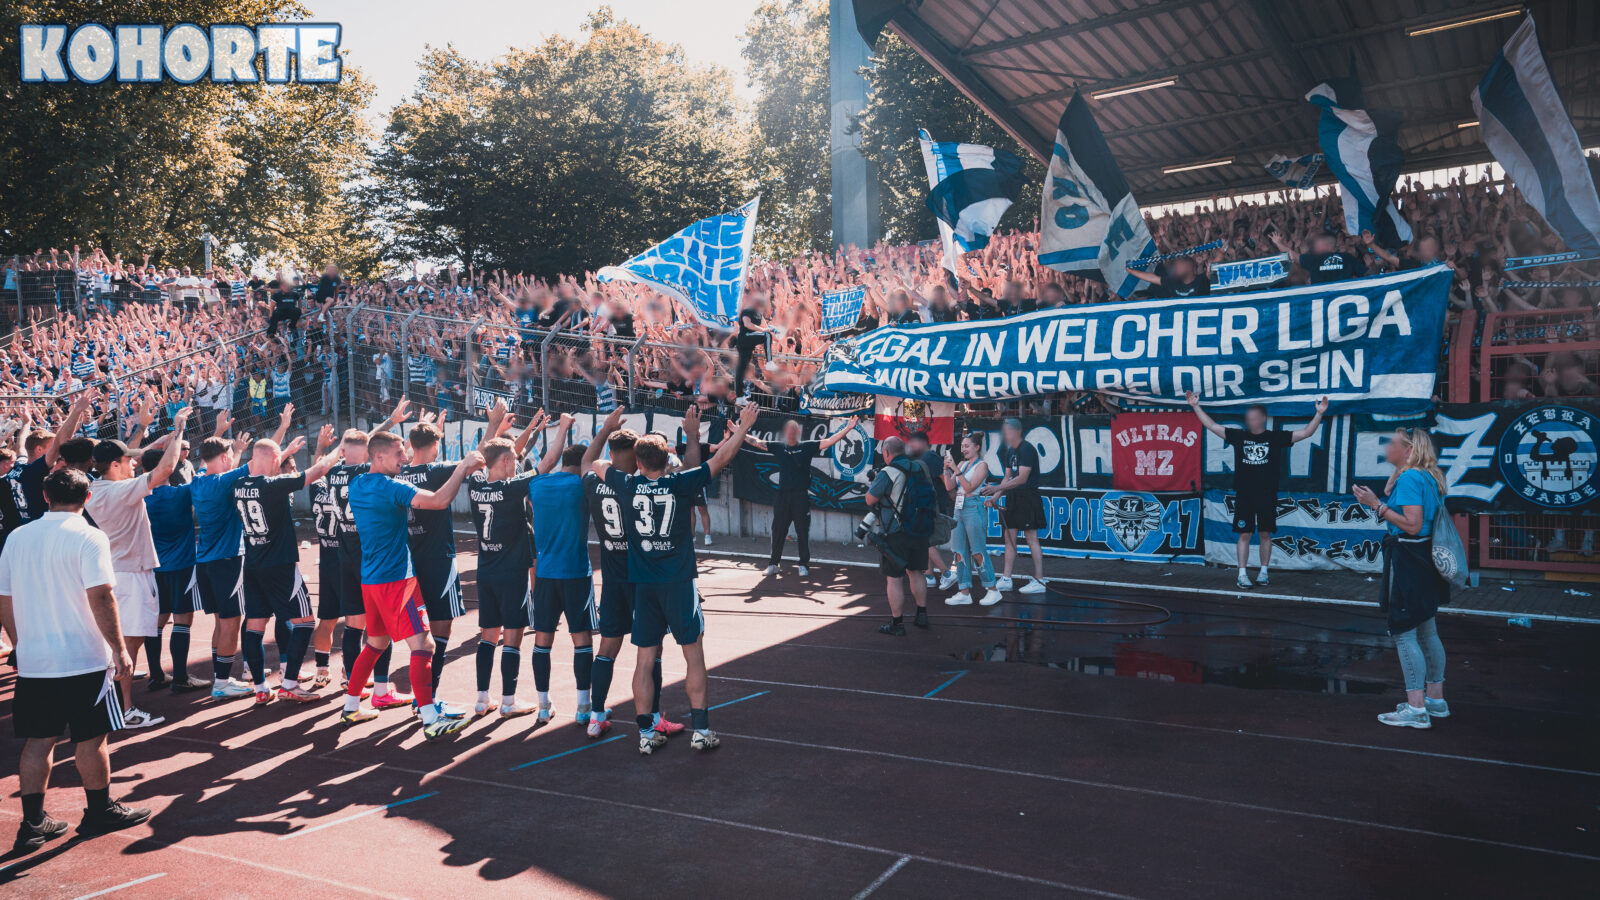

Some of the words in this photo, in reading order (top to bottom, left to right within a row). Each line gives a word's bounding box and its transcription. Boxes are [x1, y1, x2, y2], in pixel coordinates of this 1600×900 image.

[858, 334, 951, 367] EGAL
[961, 330, 1008, 366] IN
[1018, 307, 1259, 363] WELCHER
[1278, 289, 1412, 351] LIGA
[873, 367, 930, 395] WIR
[938, 369, 1084, 399] WERDEN
[1096, 366, 1162, 396] BEI
[1172, 363, 1246, 398] DIR
[1258, 349, 1364, 393] SEIN
[1116, 424, 1197, 447] ULTRAS
[1513, 408, 1591, 435] ZEBRA
[1135, 450, 1173, 475] MZ
[234, 487, 259, 498] MÜLLER
[1124, 499, 1139, 512] 47
[1522, 484, 1597, 505] BANDE
[237, 500, 269, 535] 19
[313, 503, 339, 537] 27
[478, 503, 495, 541] 7
[602, 497, 624, 538] 9
[632, 493, 676, 537] 37
[1161, 498, 1201, 549] 47
[1271, 534, 1381, 563] CREW
